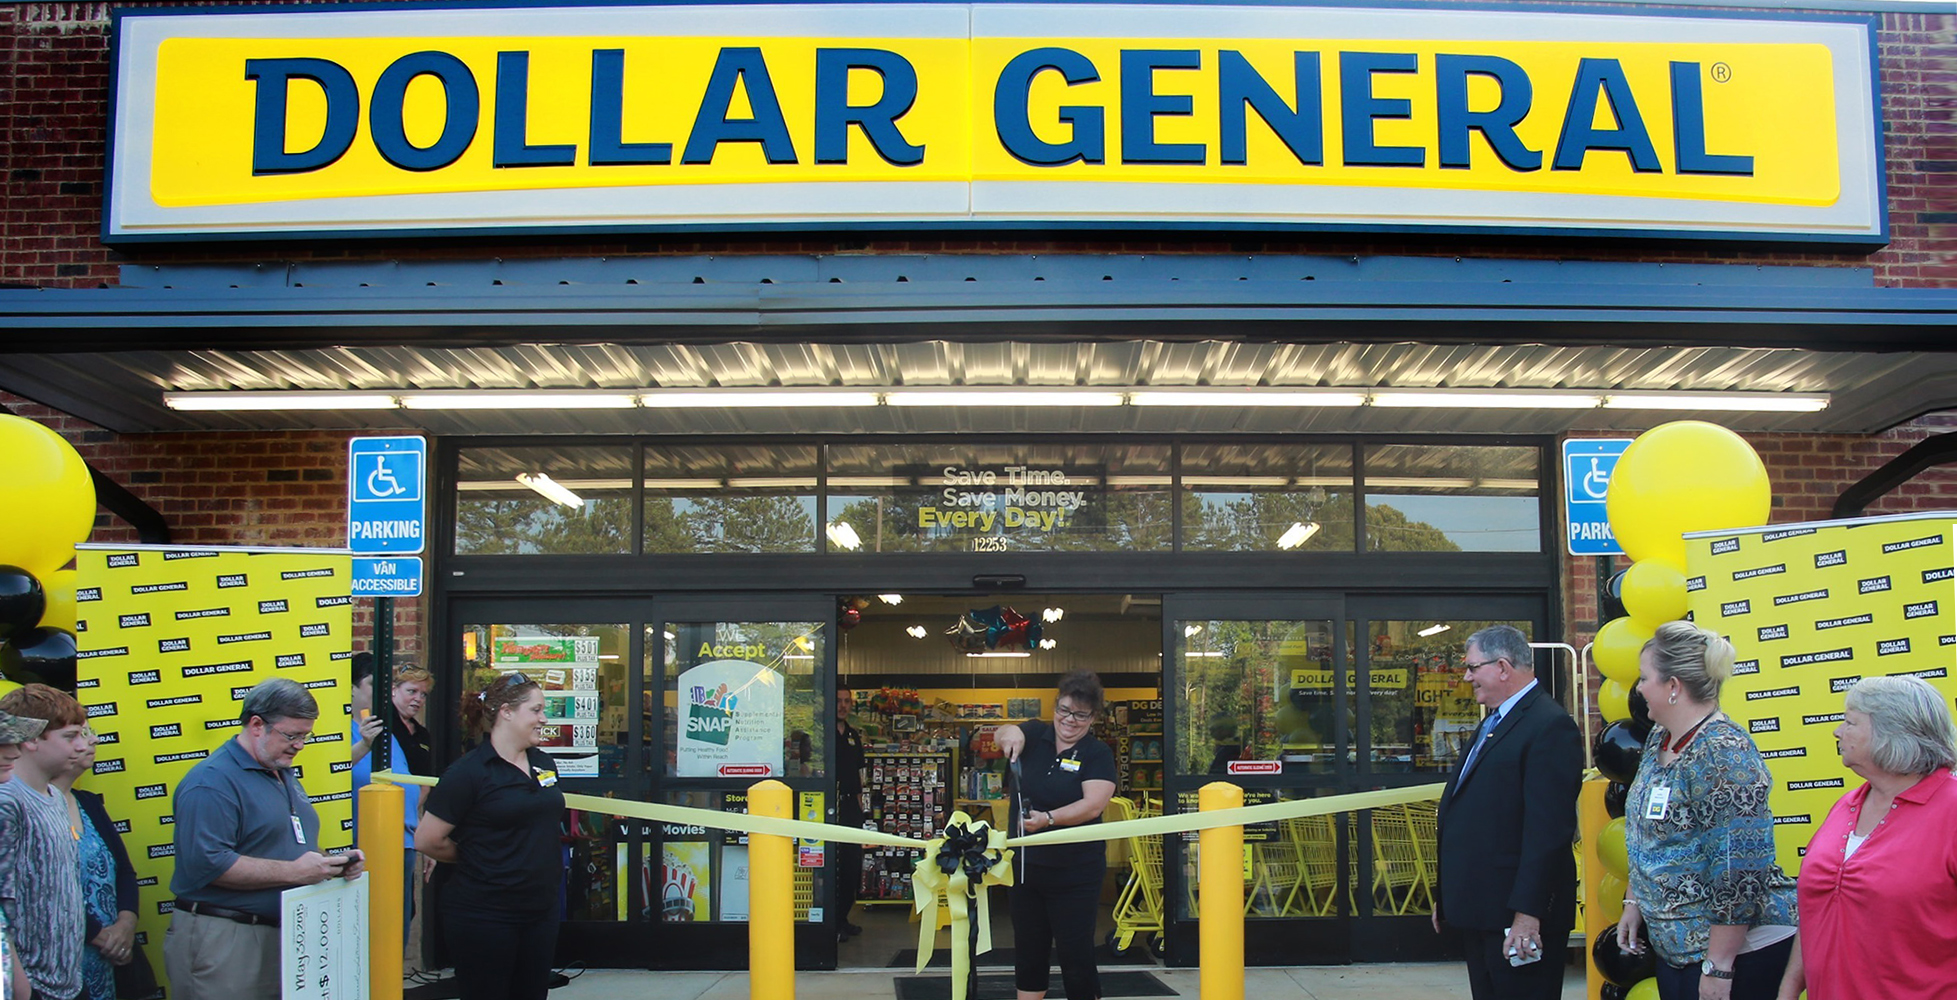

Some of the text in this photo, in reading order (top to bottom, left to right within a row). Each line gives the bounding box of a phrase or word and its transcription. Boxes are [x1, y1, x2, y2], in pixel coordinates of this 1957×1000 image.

[245, 47, 926, 176] DOLLAR
[993, 46, 1754, 176] GENERAL
[943, 466, 1071, 486] Save Time.
[943, 487, 1087, 510] Save Money.
[918, 507, 1066, 532] Every Day!
[351, 520, 420, 539] PARKING
[1570, 522, 1616, 540] PARK
[973, 537, 1008, 552] 12253
[373, 563, 397, 575] VAN
[351, 578, 417, 591] ACCESSIBLE
[698, 641, 766, 660] Accept
[1783, 651, 1850, 666] DOLLAR GENERAL
[184, 662, 252, 676] DOLLAR GENERAL
[1297, 674, 1401, 684] DOLLA GERAL
[687, 716, 732, 733] SNAP
[1119, 737, 1129, 792] DG DEALS
[662, 824, 706, 836] Movies
[295, 955, 311, 991] May
